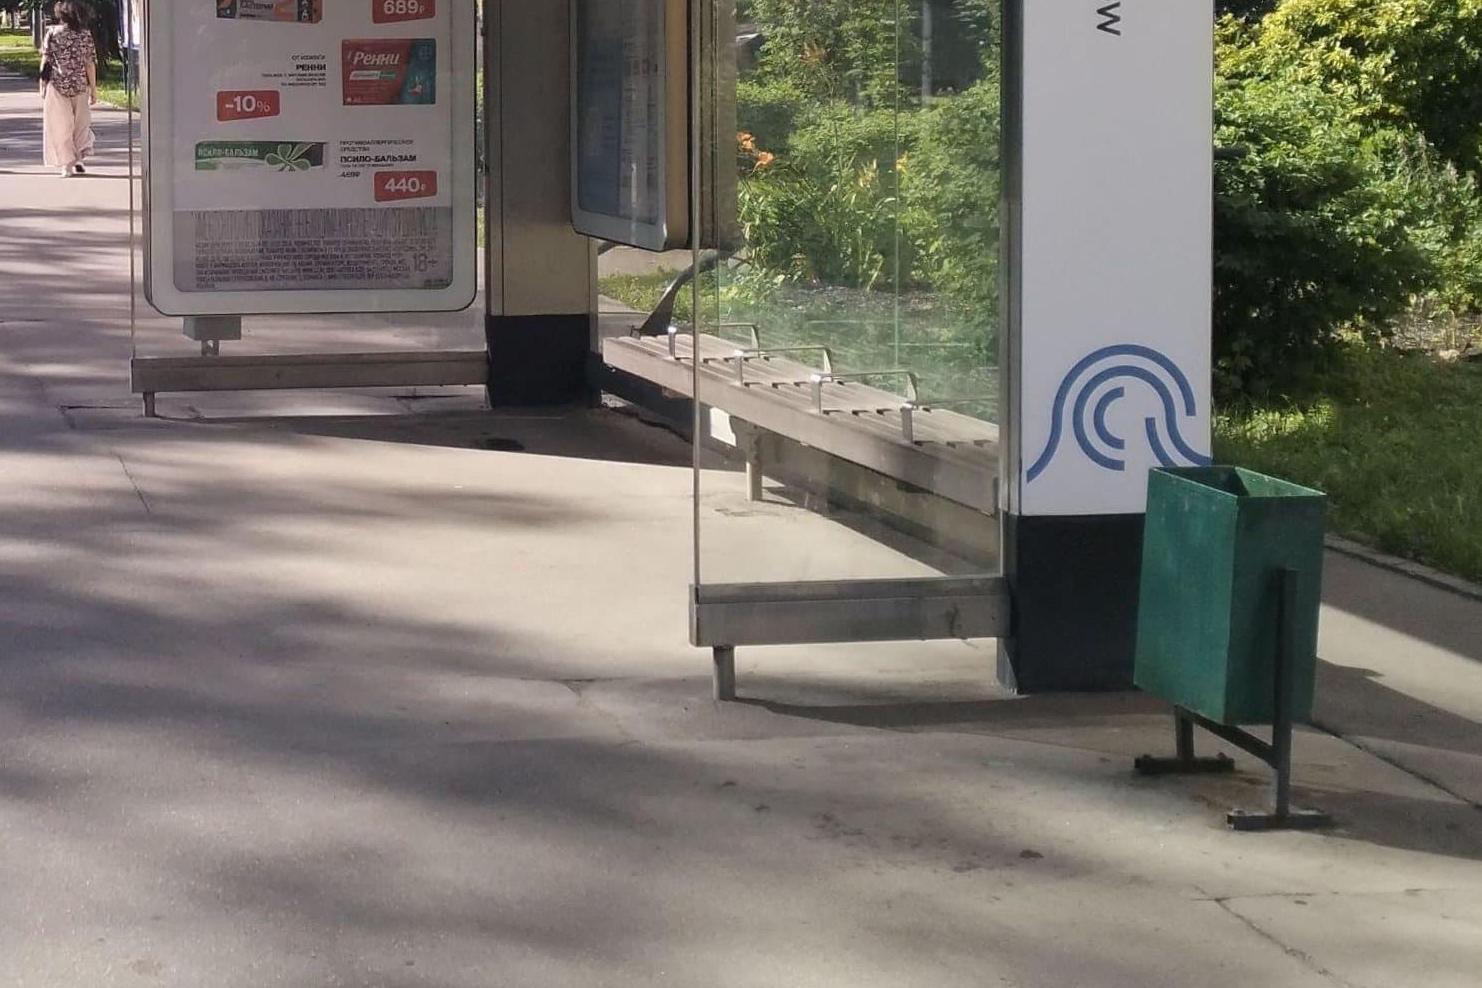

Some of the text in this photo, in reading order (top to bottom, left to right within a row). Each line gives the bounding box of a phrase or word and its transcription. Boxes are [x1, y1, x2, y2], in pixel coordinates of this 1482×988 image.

[353, 51, 400, 65] Ренни
[296, 63, 327, 71] РЕННИ
[340, 154, 417, 163] ПСИЛО-БАЛЬЗАМ
